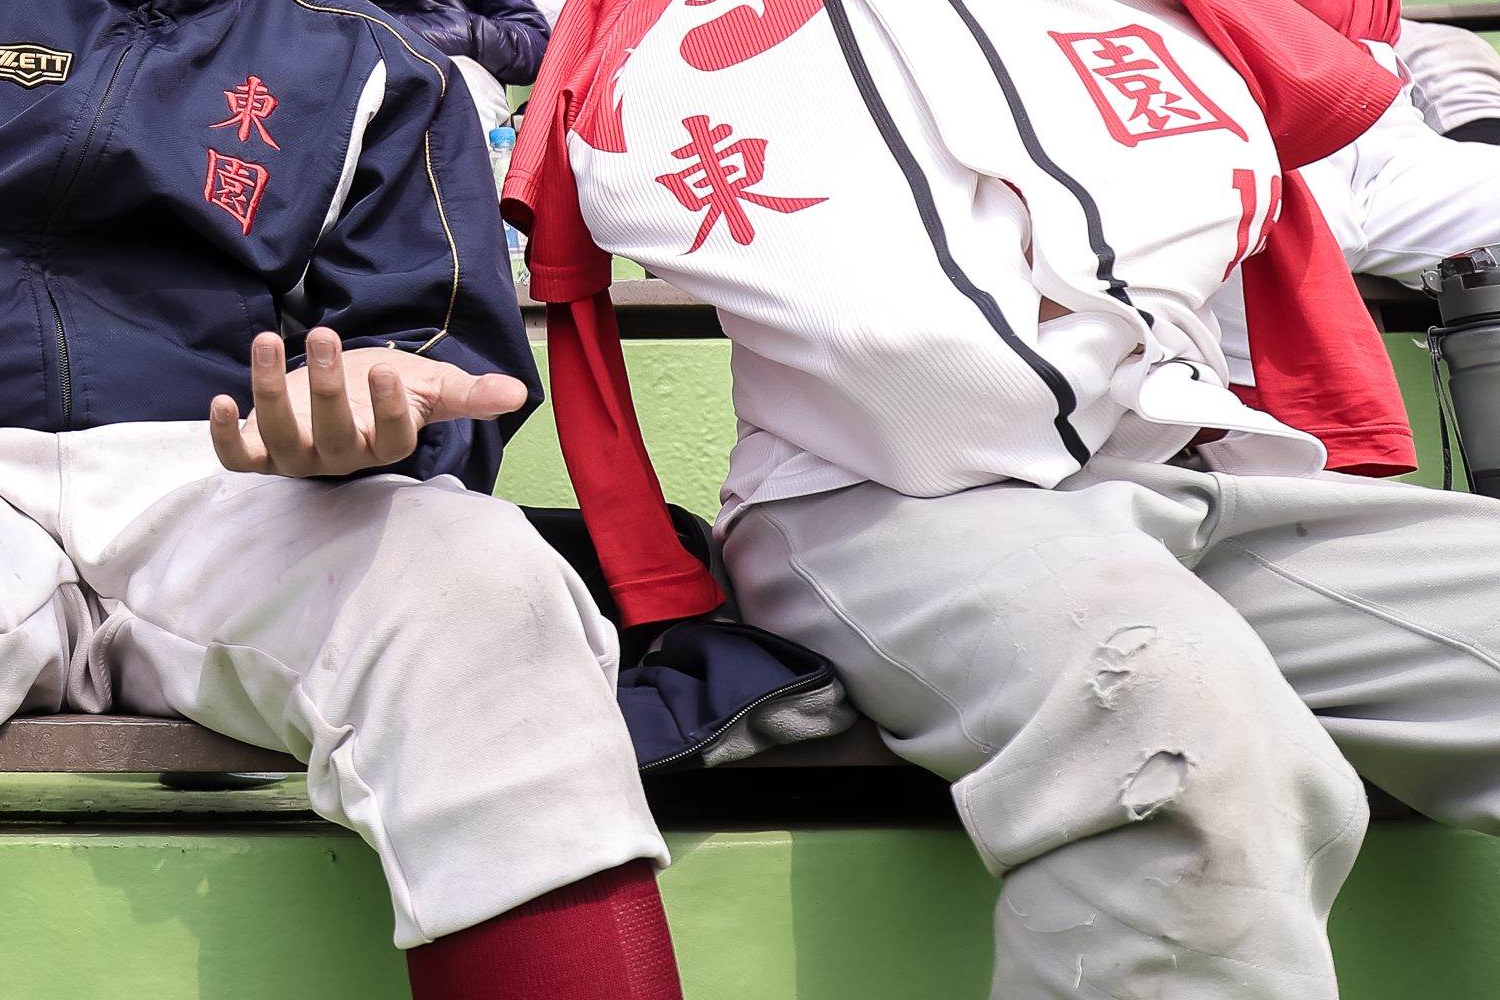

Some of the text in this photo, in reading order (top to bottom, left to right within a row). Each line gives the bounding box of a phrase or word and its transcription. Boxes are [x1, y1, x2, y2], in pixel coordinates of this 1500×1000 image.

[203, 74, 281, 237] 東園
[655, 23, 1249, 255] 東 園
